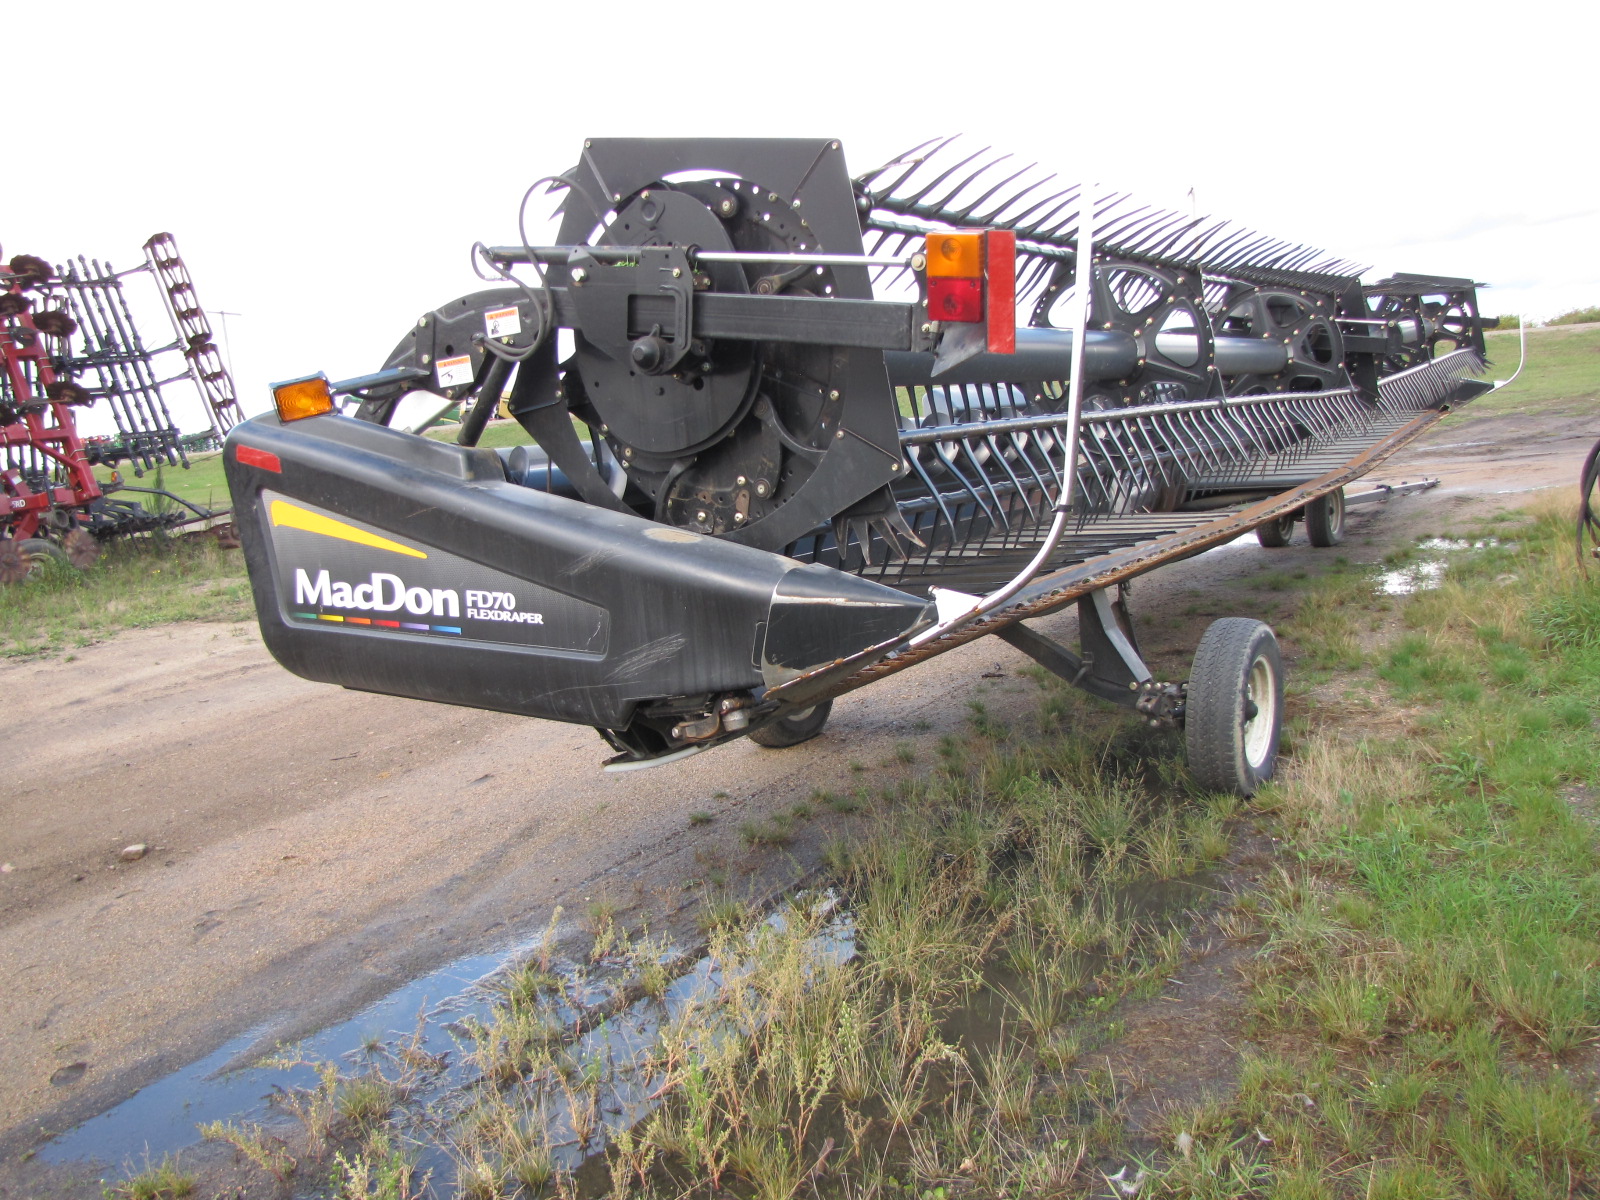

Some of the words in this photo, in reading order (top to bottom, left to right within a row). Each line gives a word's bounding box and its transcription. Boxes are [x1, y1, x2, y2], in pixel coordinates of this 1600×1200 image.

[295, 568, 460, 618] MacDon
[466, 589, 516, 611] FD70
[467, 608, 544, 625] FLEXDRAPER
